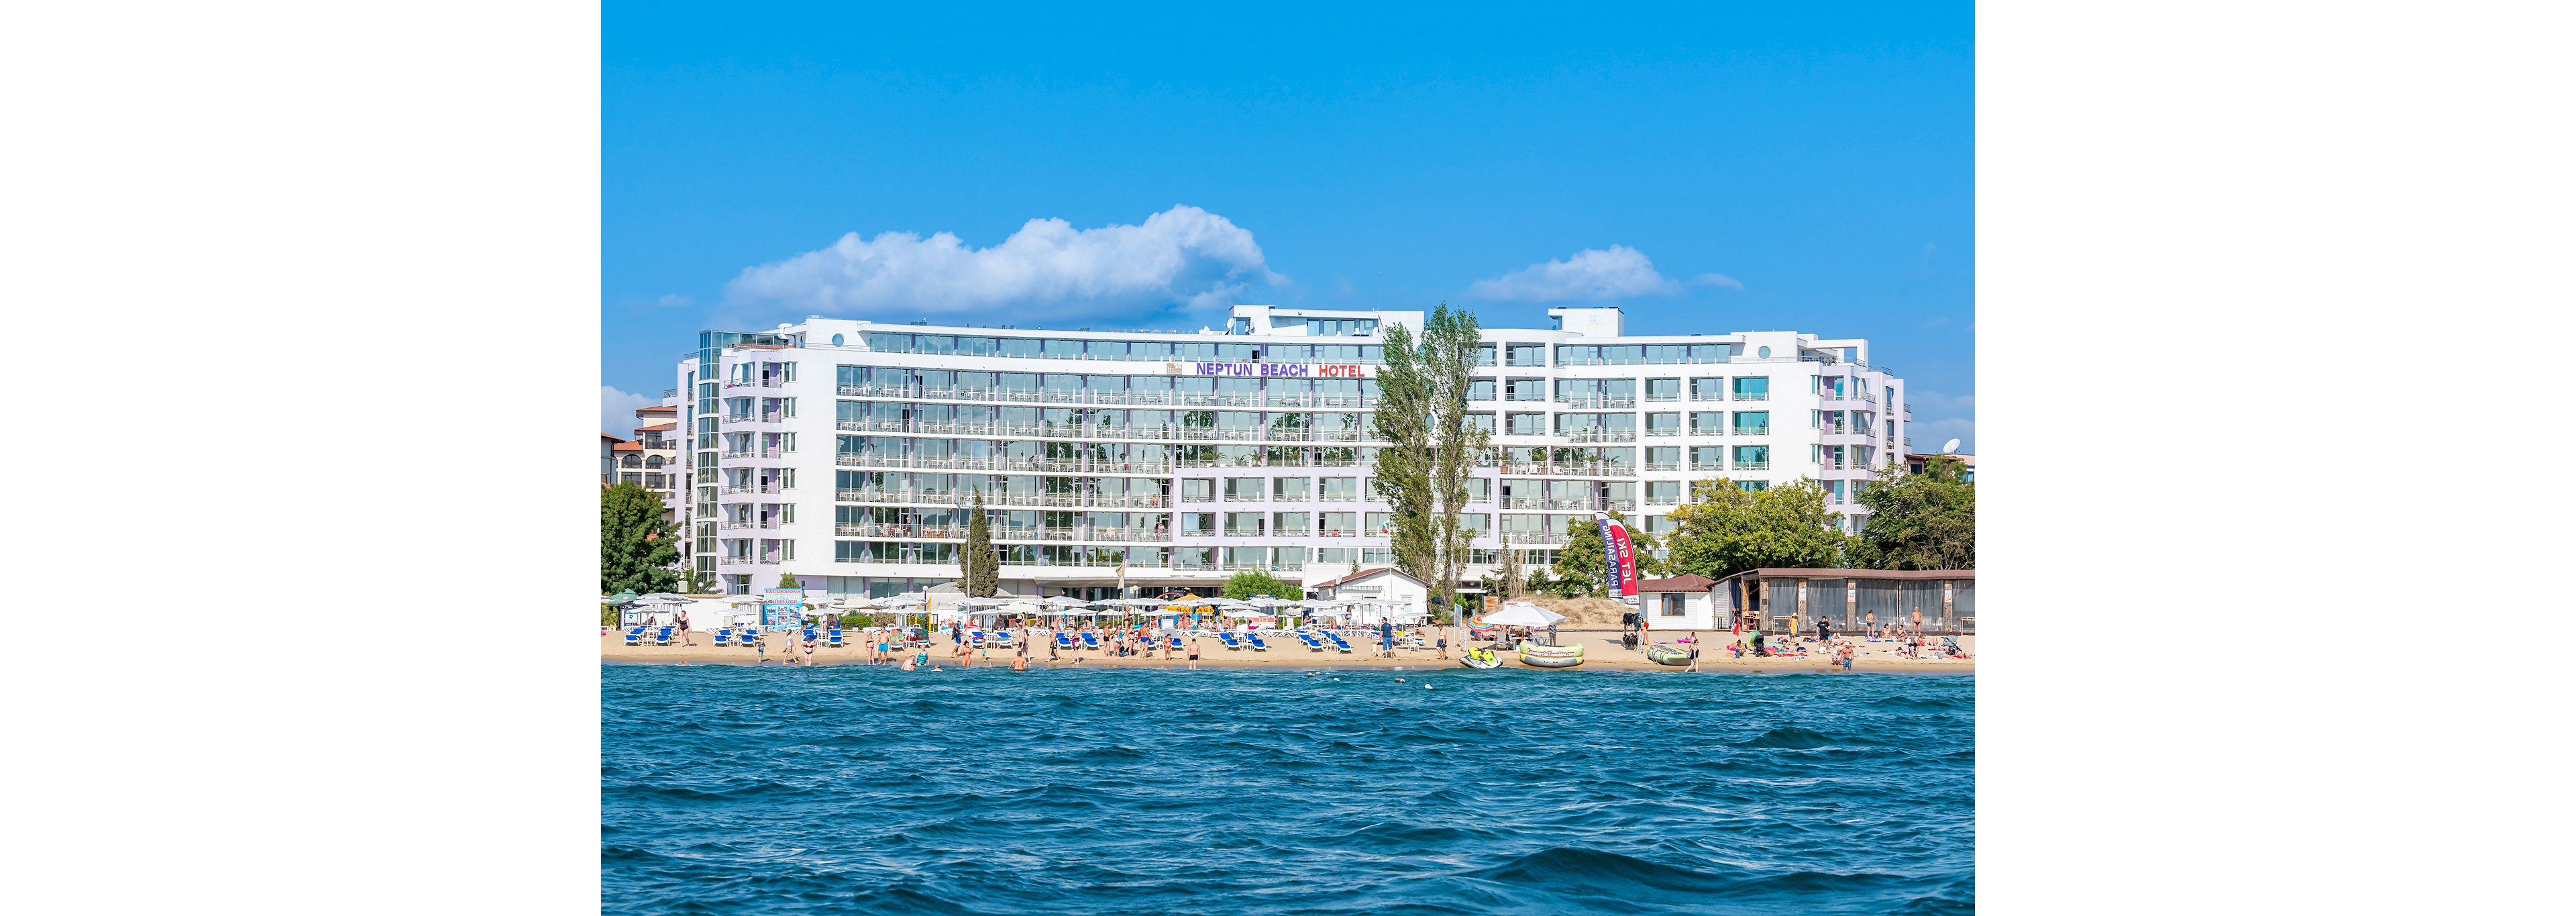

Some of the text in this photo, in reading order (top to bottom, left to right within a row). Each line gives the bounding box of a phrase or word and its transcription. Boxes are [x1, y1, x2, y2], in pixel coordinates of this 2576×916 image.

[1197, 363, 1364, 377] NEPTUN BEACH HOTEL
